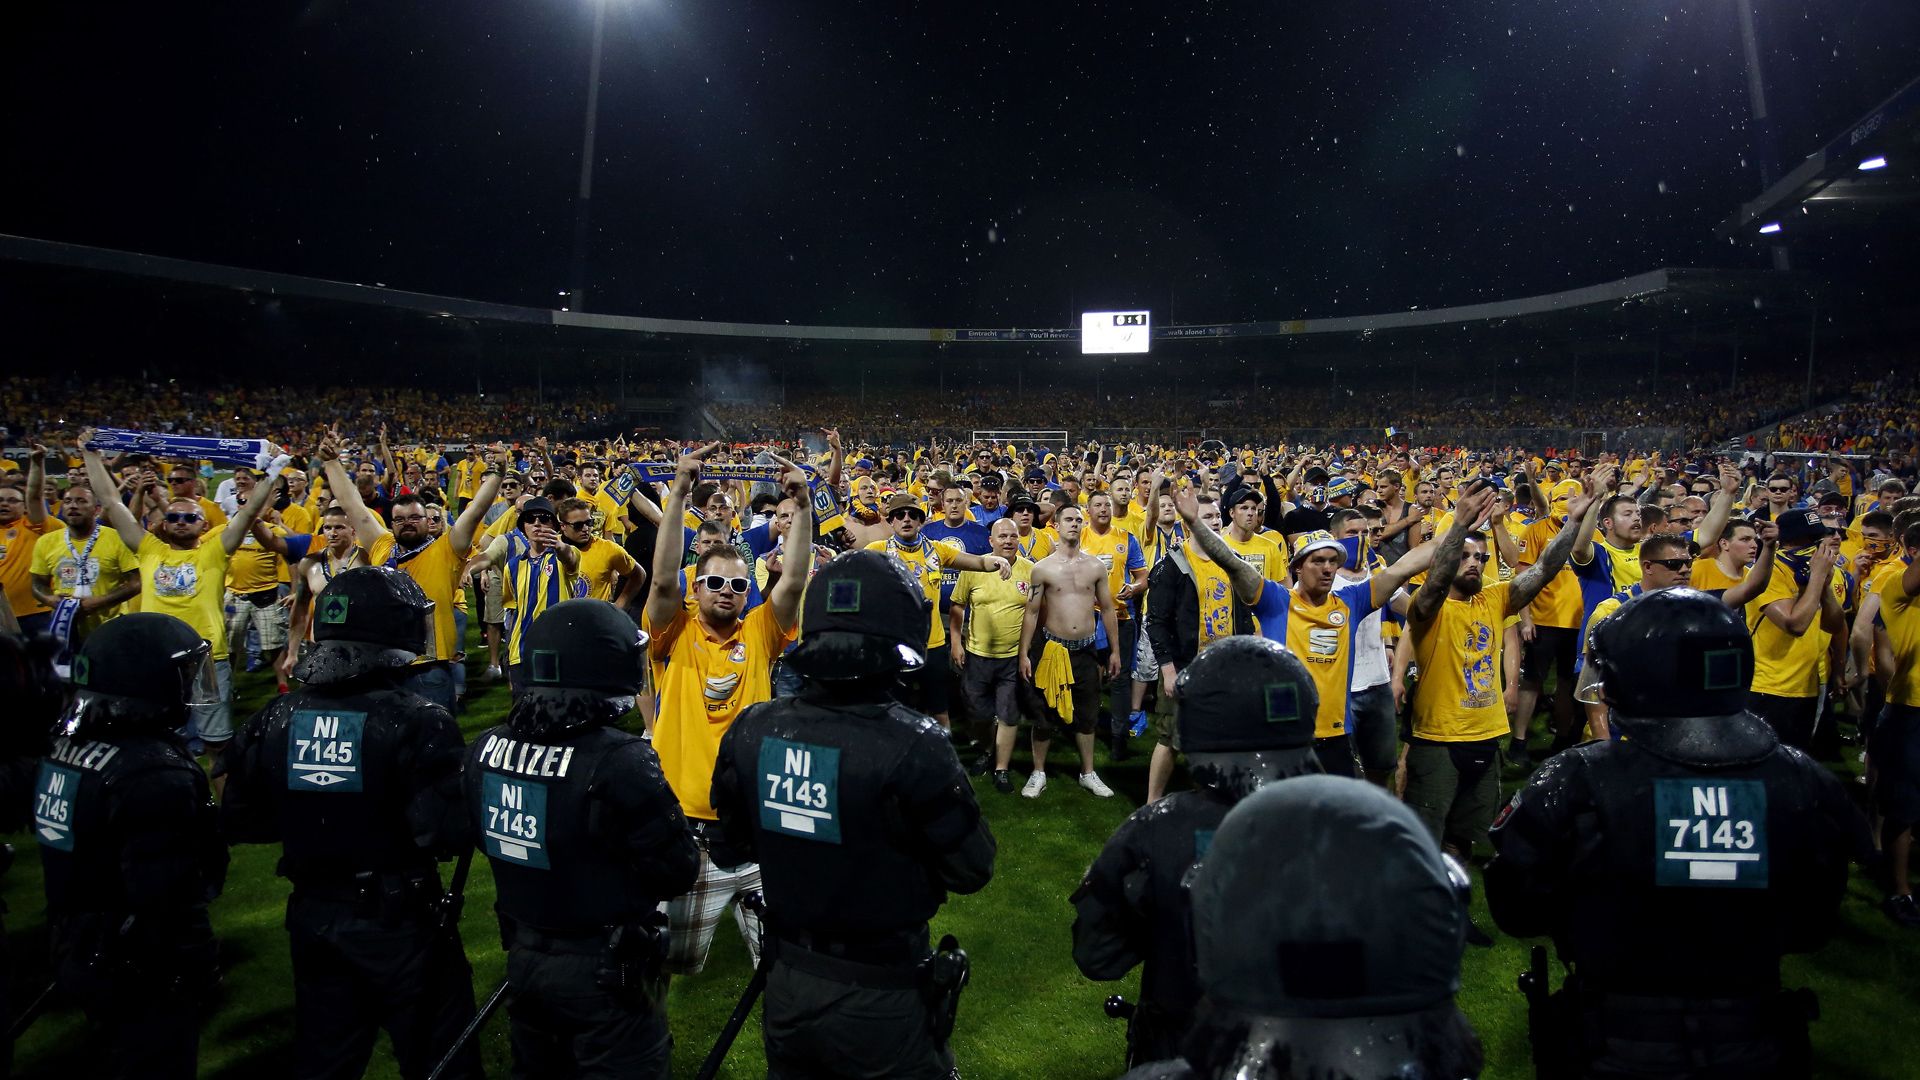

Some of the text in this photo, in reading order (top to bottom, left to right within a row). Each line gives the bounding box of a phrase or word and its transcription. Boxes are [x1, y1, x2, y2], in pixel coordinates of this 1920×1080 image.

[704, 699, 736, 712] EAT
[313, 716, 339, 738] NI
[48, 738, 120, 771] OLIZEI
[296, 739, 353, 763] 7145
[479, 734, 575, 777] POLIZEI
[784, 747, 811, 777] NI
[48, 771, 66, 796] NI
[501, 783, 523, 810] NI
[766, 773, 828, 809] 7143
[37, 793, 69, 822] 7145
[1692, 786, 1728, 816] NI
[488, 805, 537, 840] 7143
[1669, 819, 1755, 849] 7143
